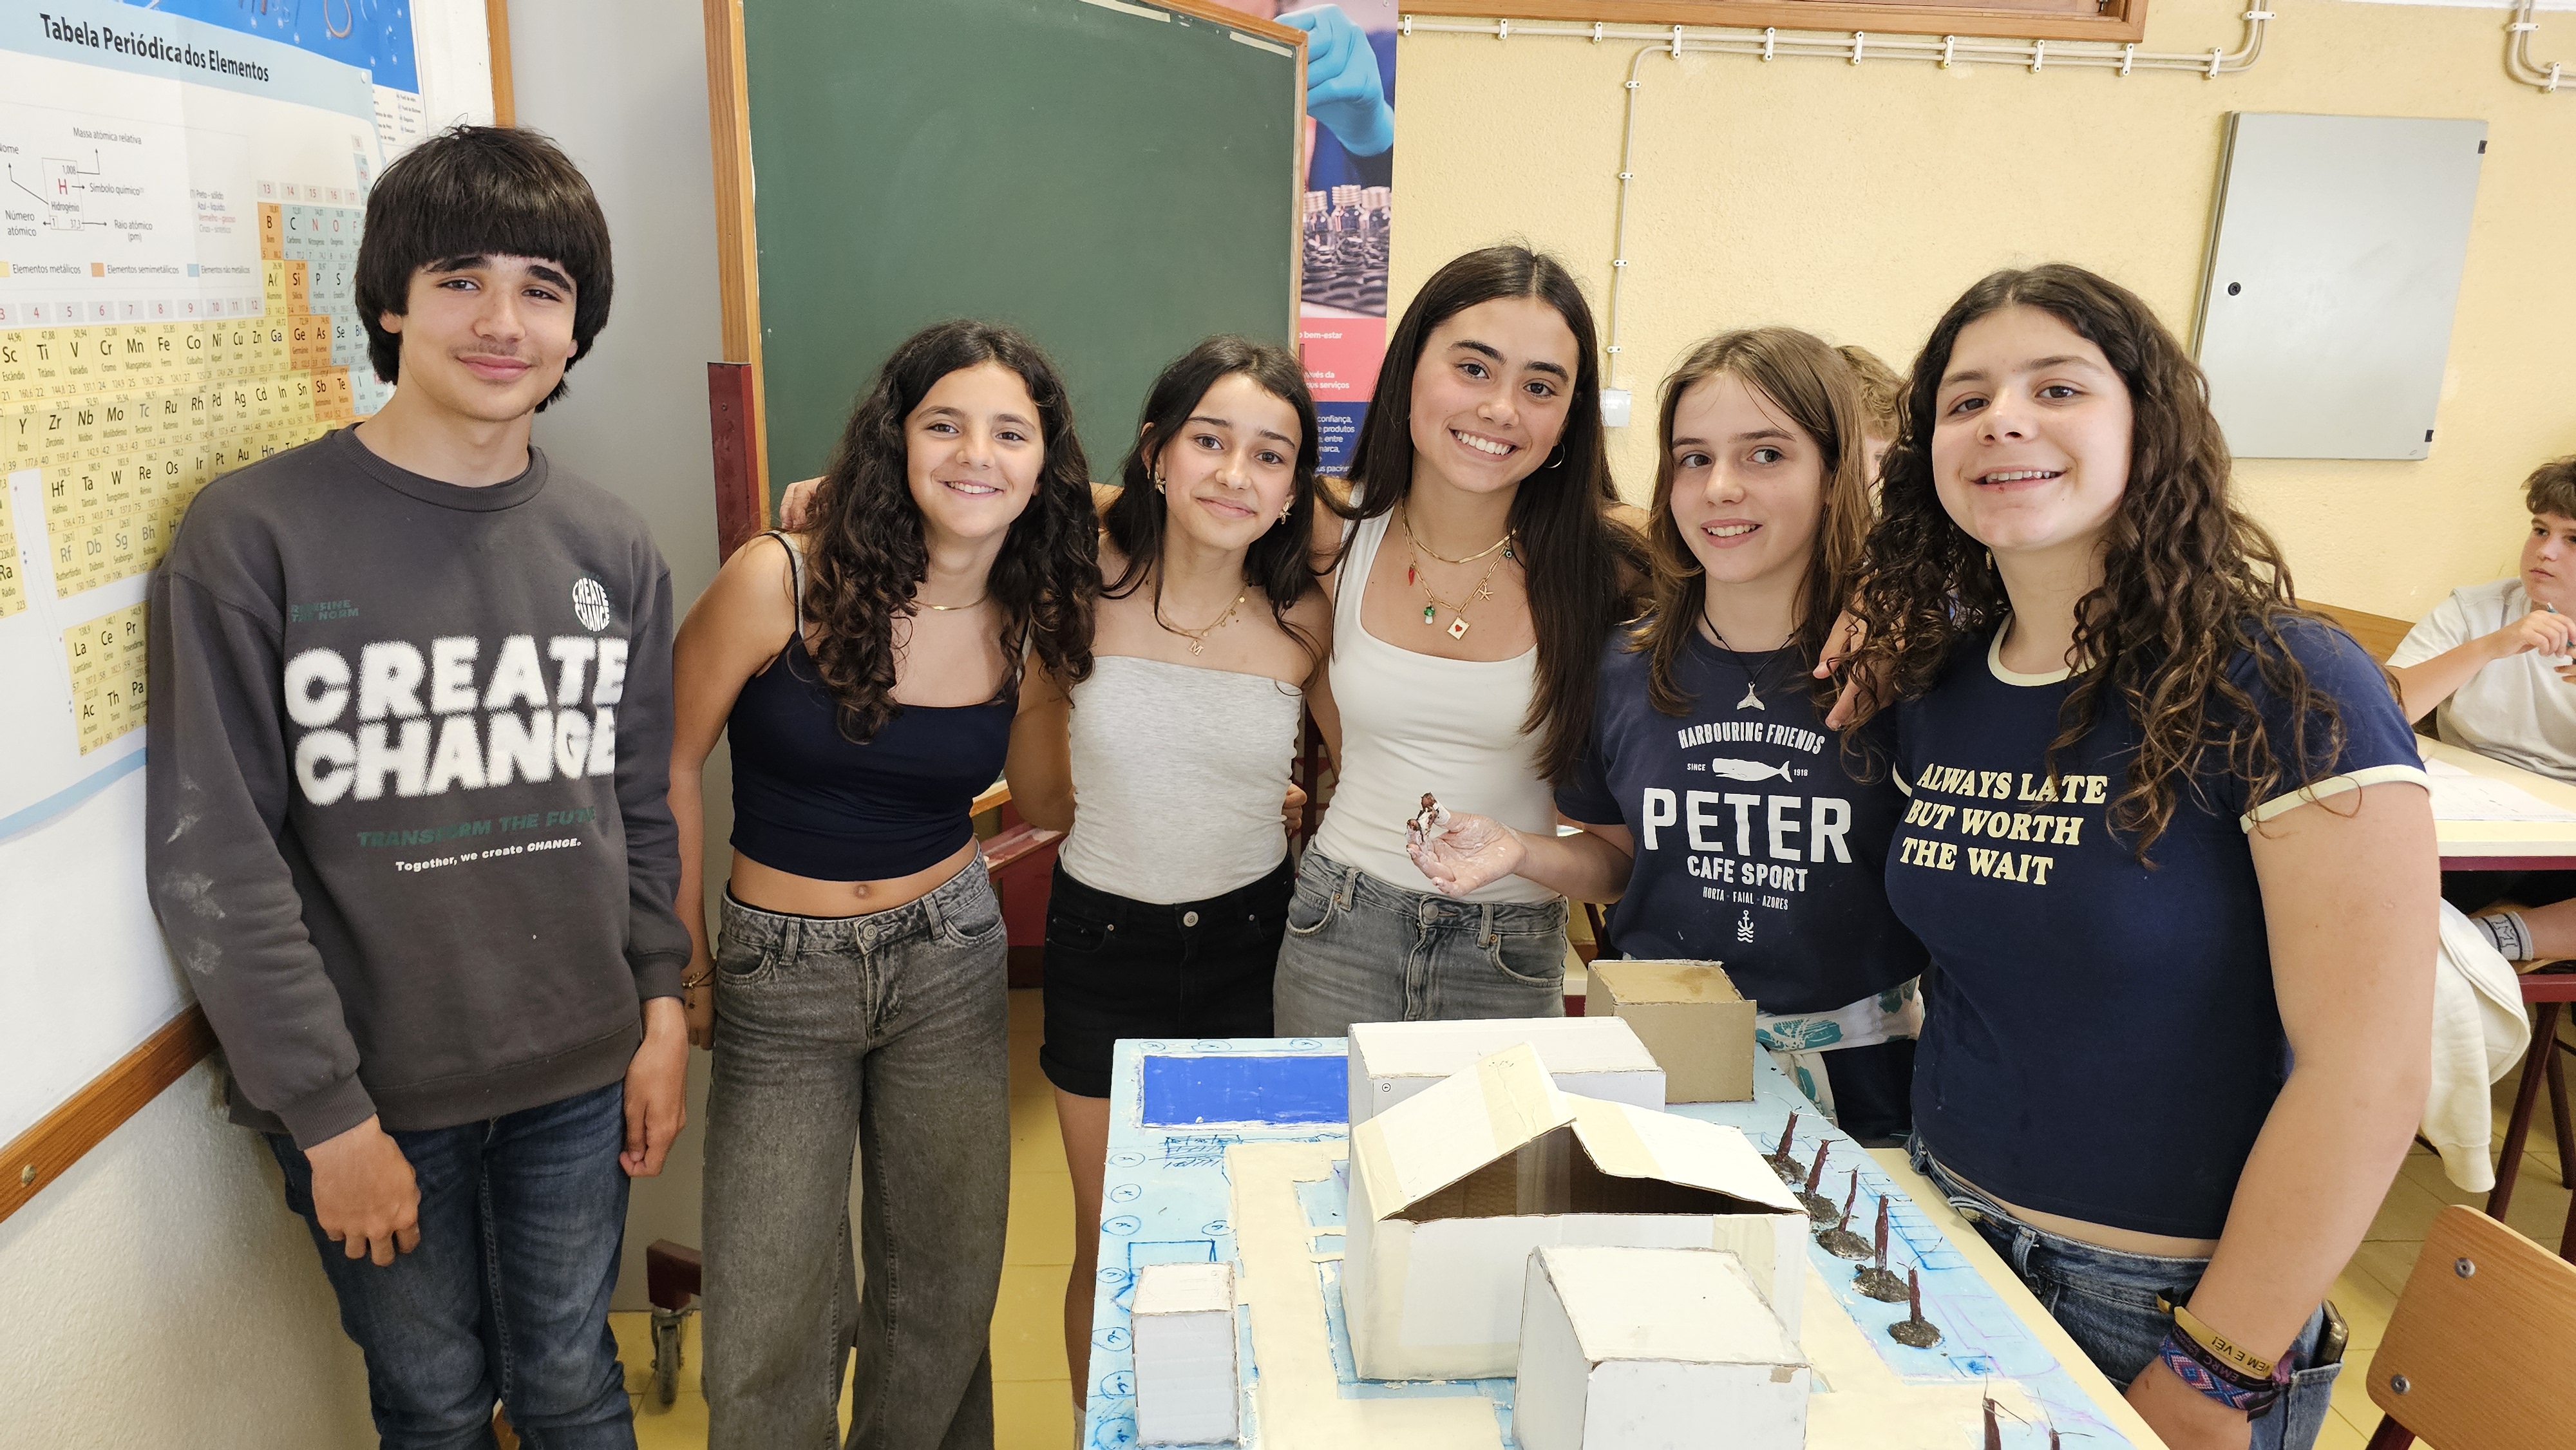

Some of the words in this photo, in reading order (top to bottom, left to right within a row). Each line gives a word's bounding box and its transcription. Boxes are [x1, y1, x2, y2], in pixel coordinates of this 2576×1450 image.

[39, 13, 100, 48] Tabela
[103, 26, 182, 63] Periódica
[184, 44, 206, 69] dos
[209, 50, 269, 82] Elementos
[73, 127, 92, 138] Massa
[93, 129, 117, 141] atómica
[118, 133, 142, 144] relativa
[0, 142, 19, 155] ome
[62, 165, 76, 174] 1,008
[58, 178, 68, 194] H
[90, 183, 114, 193] Símbolo
[263, 184, 270, 194] 13
[287, 187, 294, 196] 14
[309, 189, 316, 198] 15
[331, 191, 337, 200] 16
[51, 202, 80, 214] Hidrogénio
[5, 210, 35, 221] Número
[267, 216, 272, 229] B
[114, 220, 128, 229] Raio
[129, 220, 153, 231] atómico
[290, 217, 296, 230] C
[312, 218, 319, 231] N
[333, 220, 339, 232] O
[7, 227, 37, 237] atómico
[128, 232, 142, 243] (pm)
[13, 264, 48, 274] Elementos
[50, 264, 80, 274] metálicos
[108, 265, 137, 274] Elementos
[138, 264, 179, 274] semimetálicos
[292, 273, 301, 286] Si
[316, 273, 321, 285] P
[336, 273, 341, 285] S
[67, 306, 72, 317] 5
[99, 305, 105, 316] 6
[128, 305, 133, 315] 7
[158, 303, 163, 314] 8
[188, 303, 193, 313] 9
[213, 302, 220, 312] 10
[232, 301, 238, 310] 11
[251, 300, 258, 310] 12
[34, 307, 39, 318] 4
[233, 332, 243, 346] Cu
[252, 331, 261, 344] Zn
[271, 329, 282, 342] Ga
[294, 328, 305, 341] Ge
[317, 327, 326, 340] As
[337, 326, 345, 338] Se
[1304, 331, 1343, 339] bem-estar
[100, 340, 112, 355] Cr
[127, 338, 144, 353] Mn
[158, 337, 170, 352] Fe
[187, 335, 201, 349] Co
[213, 334, 222, 347] Ni
[3, 346, 17, 363] Sc
[36, 344, 49, 360] Ti
[70, 342, 78, 357] V
[298, 382, 307, 396] Sn
[316, 379, 326, 393] Sb
[337, 378, 345, 390] Te
[1320, 381, 1350, 390] serviços
[234, 391, 246, 407] Ag
[256, 387, 267, 401] Cd
[278, 386, 287, 399] In
[191, 396, 204, 411] Rh
[212, 392, 222, 408] Pd
[107, 407, 124, 422] Mo
[139, 403, 149, 418] Tc
[165, 400, 177, 415] Ru
[49, 415, 61, 430] Zr
[78, 410, 94, 426] Nb
[1317, 415, 1352, 424] confiança,
[19, 418, 27, 434] Y
[1323, 426, 1355, 434] produtos
[216, 452, 224, 466] Pt
[238, 448, 249, 462] Au
[166, 461, 178, 475] Os
[196, 457, 204, 470] Ir
[111, 470, 122, 485] W
[139, 466, 151, 480] Re
[52, 480, 64, 498] Hf
[82, 476, 93, 491] Ta
[142, 525, 155, 540] Bh
[86, 538, 102, 556] Db
[115, 533, 128, 550] Sg
[60, 545, 71, 563] Rf
[0, 565, 13, 580] Ra
[573, 578, 609, 607] CREATE
[319, 607, 359, 620] NORM
[575, 603, 610, 632] CHANGE
[126, 621, 136, 636] Pr
[101, 630, 113, 646] Ce
[74, 642, 87, 657] La
[1188, 639, 1204, 656] M
[132, 681, 144, 696] Pa
[284, 634, 629, 729] CREATE
[108, 690, 119, 706] Th
[83, 704, 95, 719] Ac
[1678, 722, 1763, 749] HARBOURING
[1766, 724, 1825, 755] FRIENDS
[294, 707, 616, 806] CHANGE
[1687, 763, 1706, 771] SINCE
[1917, 763, 2012, 800] ALWAYS
[2018, 773, 2108, 804] LATE
[1643, 787, 1853, 864] PETER
[1904, 799, 1956, 831] BUT
[1961, 808, 2084, 845] WORTH
[357, 819, 492, 847] TRANSFORM
[499, 813, 540, 833] THE
[395, 856, 457, 872] Together,
[460, 851, 478, 862] we
[482, 845, 523, 859] create
[527, 838, 582, 852] CHANGE.
[1900, 837, 1958, 871] THE
[1967, 847, 2054, 885] WAIT
[1687, 855, 1735, 883] CAFE
[1741, 863, 1808, 892] SPORT
[1703, 887, 1725, 901] HORTA
[1733, 891, 1754, 905] FAIAL
[1762, 895, 1788, 910] AZORES
[2211, 1336, 2233, 1355] VÊ!
[2234, 1351, 2246, 1362] E
[2203, 1355, 2239, 1381] EMRC
[2247, 1357, 2270, 1373] VEM
